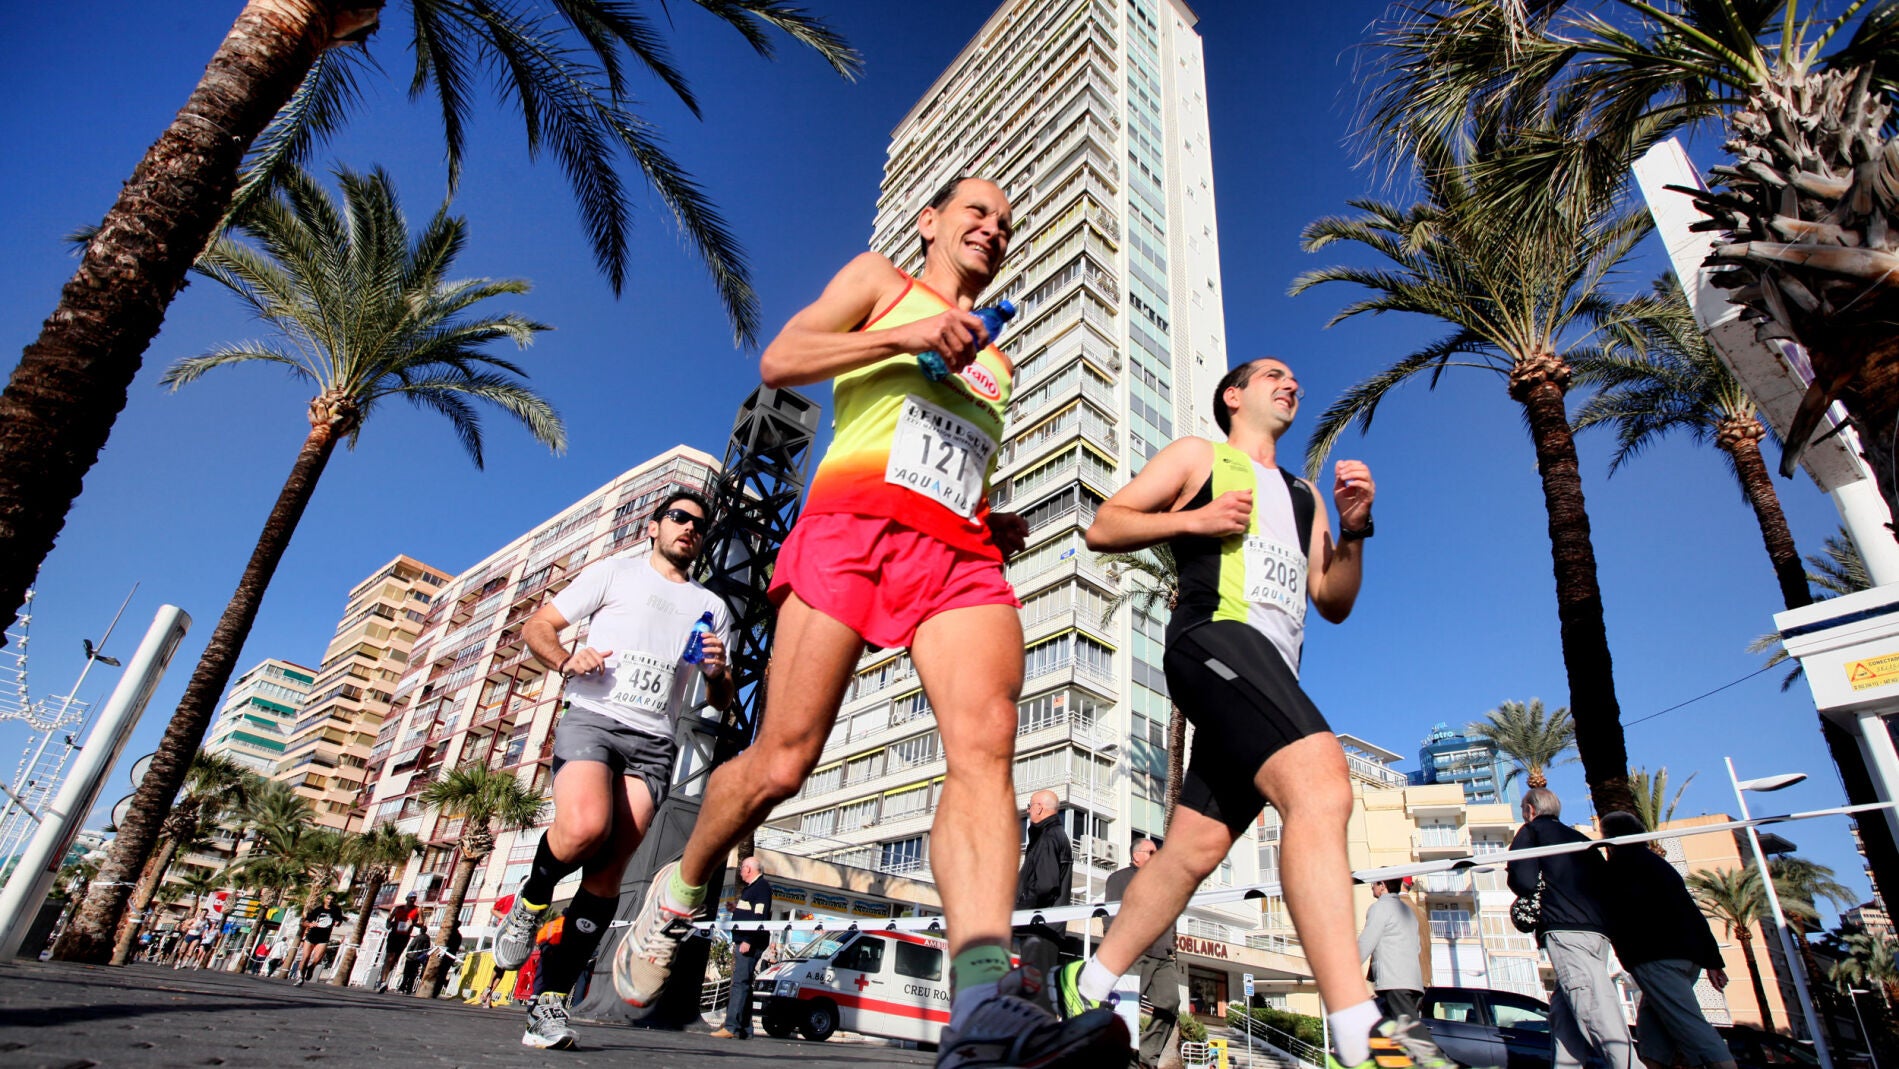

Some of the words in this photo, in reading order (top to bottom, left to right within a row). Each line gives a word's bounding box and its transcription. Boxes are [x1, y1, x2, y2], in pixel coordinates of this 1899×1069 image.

[921, 434, 968, 482] 121
[1264, 557, 1298, 593] 208
[629, 669, 661, 694] 456
[614, 692, 668, 711] AQUARIUS
[904, 984, 931, 998] CREU
